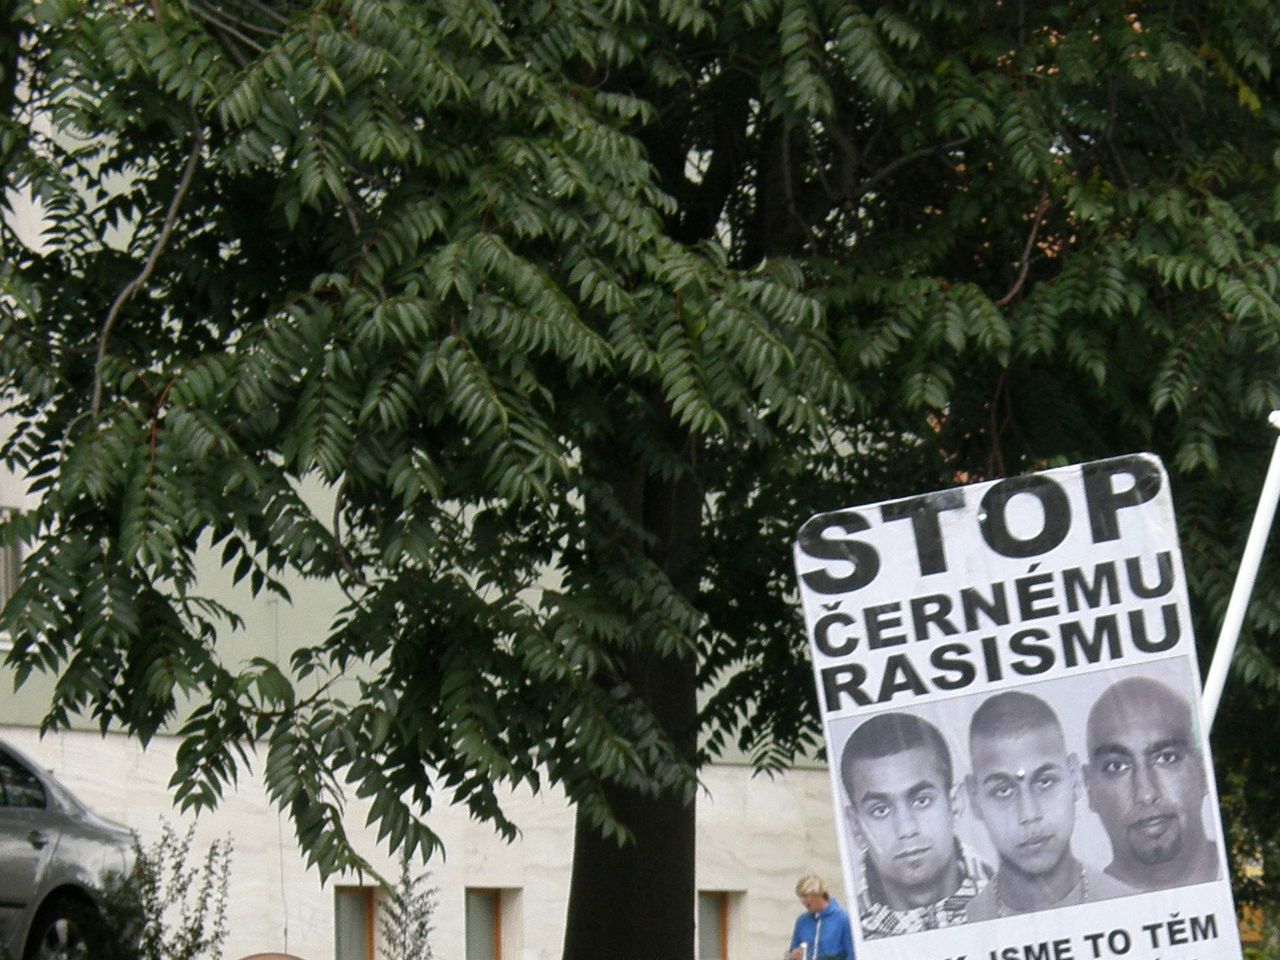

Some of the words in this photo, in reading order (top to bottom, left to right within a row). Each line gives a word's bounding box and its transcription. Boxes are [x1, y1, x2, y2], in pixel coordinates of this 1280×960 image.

[799, 455, 1163, 594] STOP
[813, 551, 1176, 657] ČERNÉMU
[820, 603, 1182, 712] RASISMU
[1084, 929, 1132, 959] TO
[1142, 913, 1219, 949] TĚM
